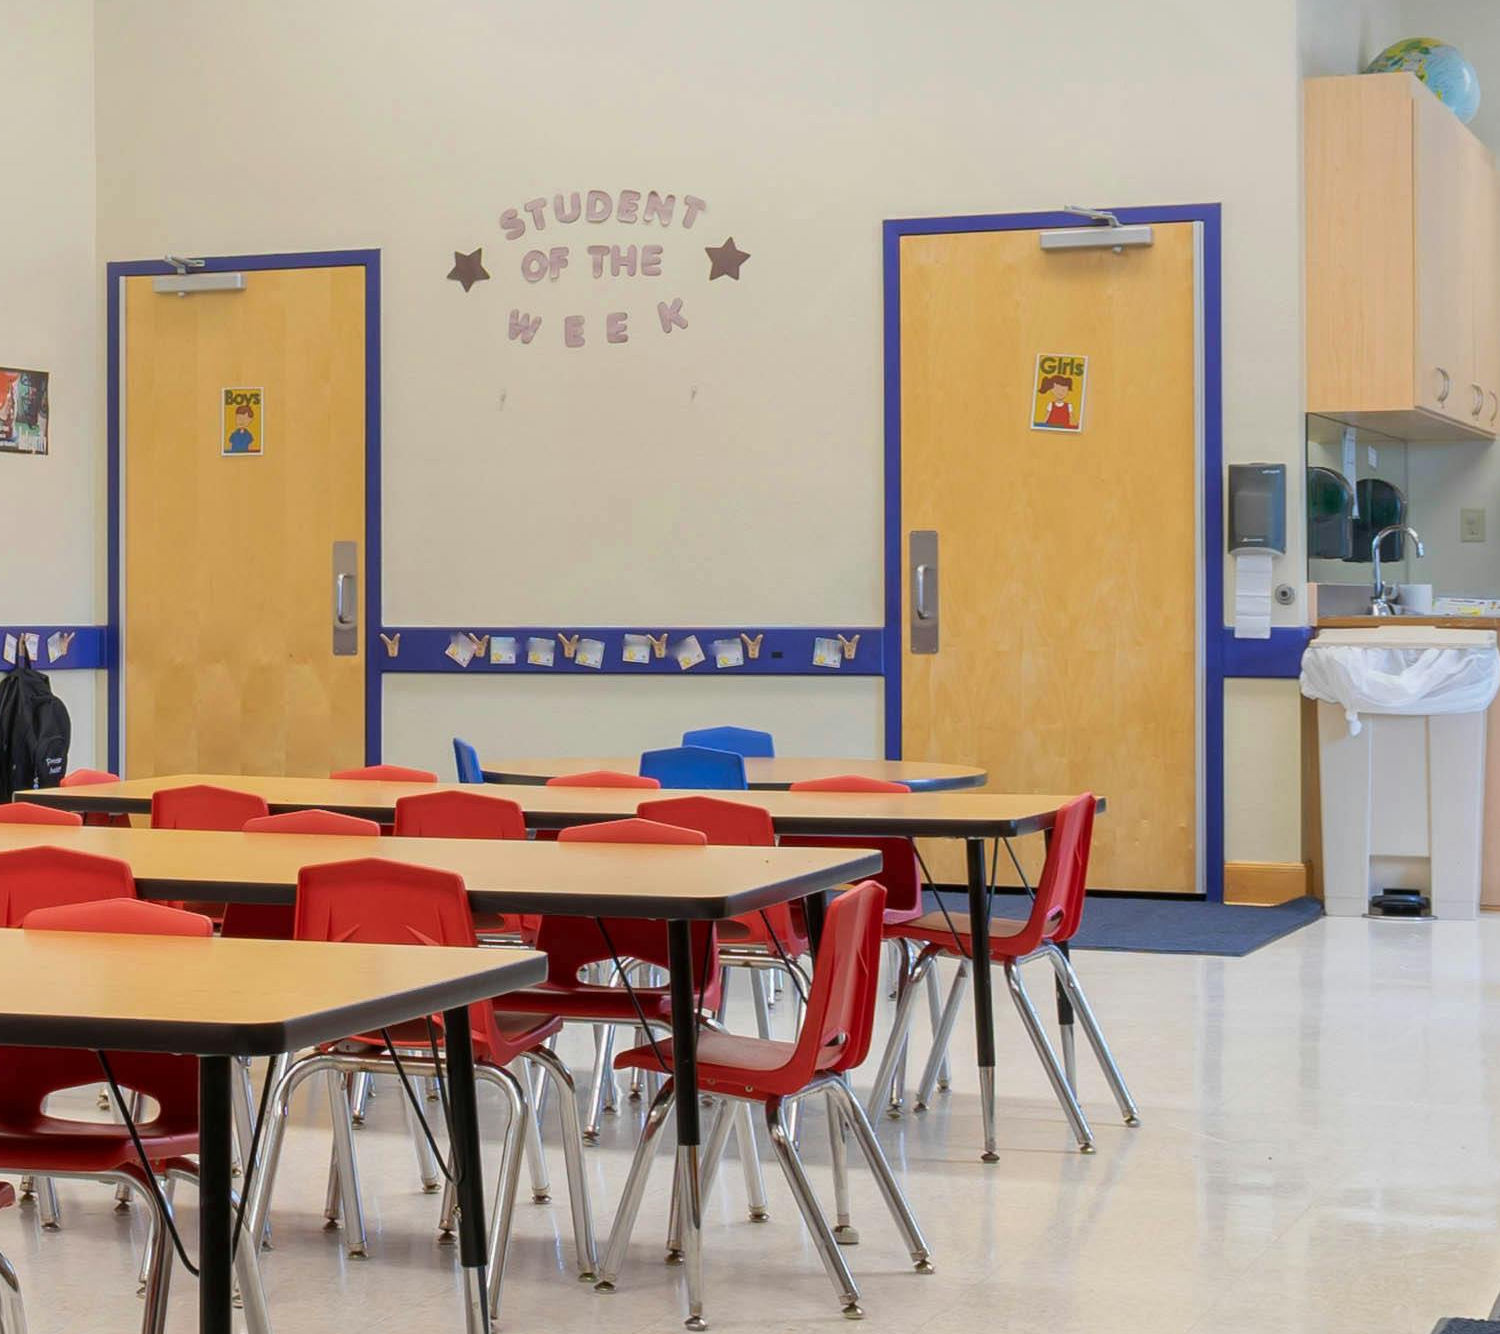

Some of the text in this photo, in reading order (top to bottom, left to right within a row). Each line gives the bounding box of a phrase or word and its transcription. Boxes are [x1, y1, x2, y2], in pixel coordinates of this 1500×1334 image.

[499, 189, 706, 241] STUDENT
[521, 244, 664, 283] OF THE
[507, 298, 688, 348] WEEK
[1041, 357, 1084, 376] Girls
[224, 389, 260, 406] Boys
